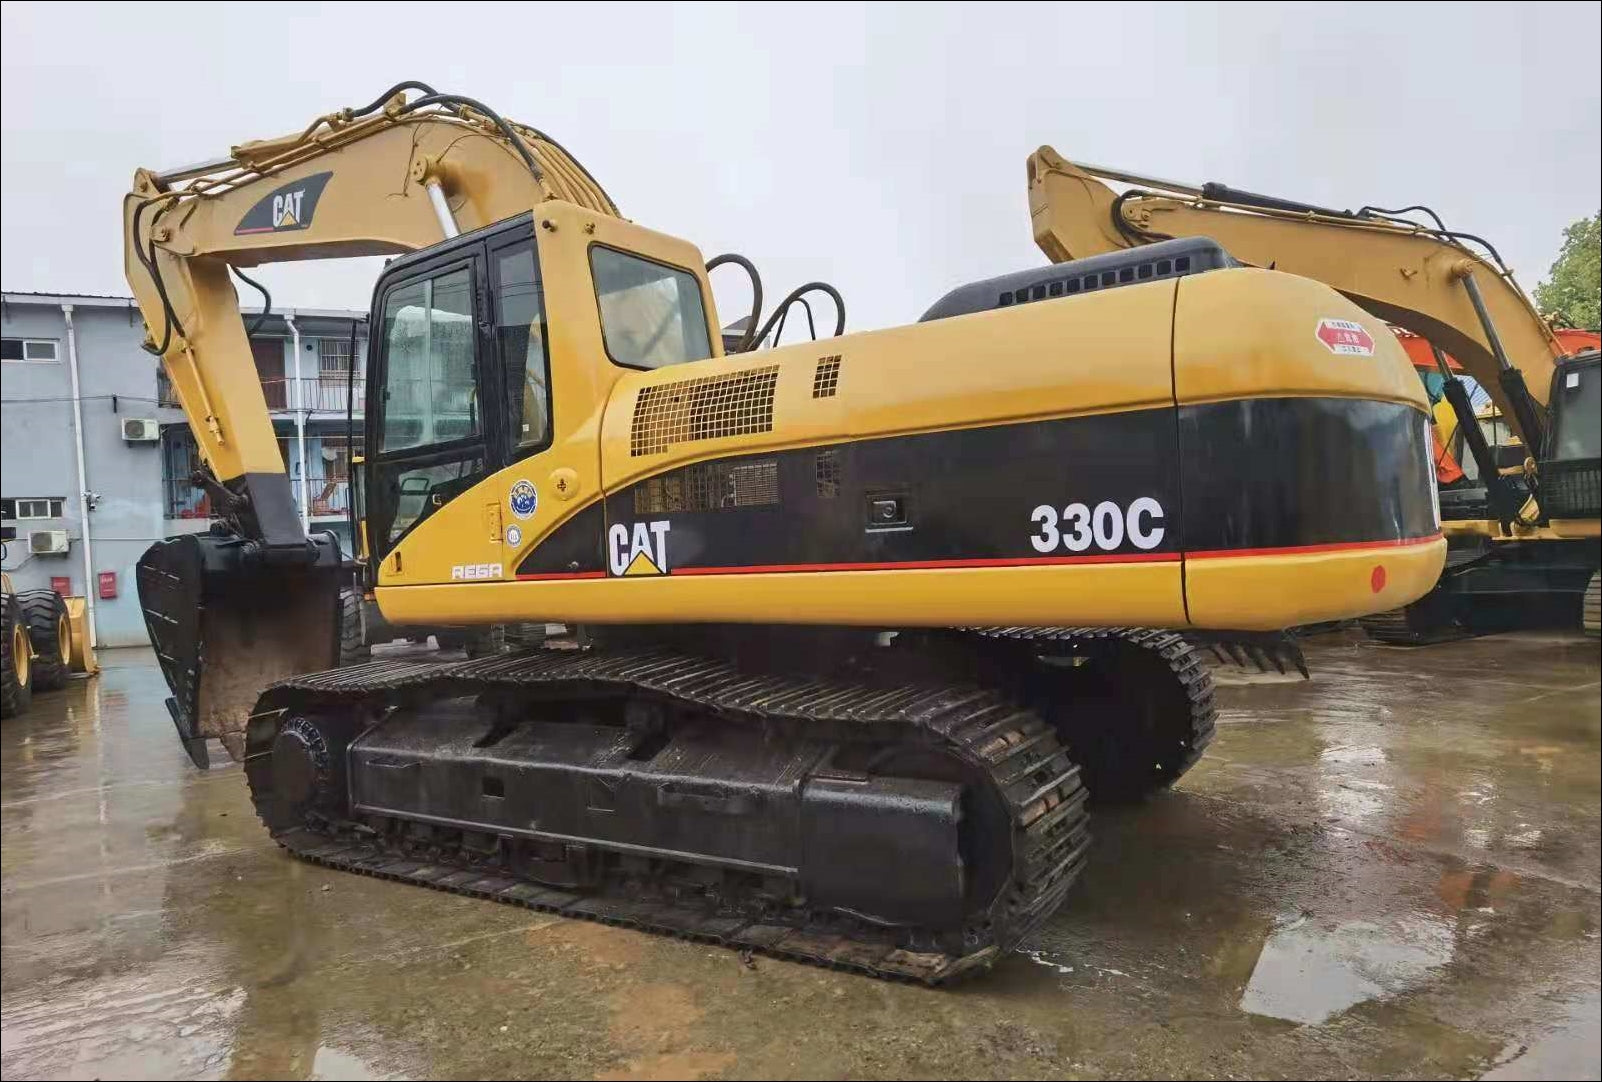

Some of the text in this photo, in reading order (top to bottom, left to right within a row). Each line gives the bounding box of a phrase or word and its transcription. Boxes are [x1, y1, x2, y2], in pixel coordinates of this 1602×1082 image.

[272, 188, 306, 228] CAT
[608, 520, 671, 576] CAT
[1030, 496, 1165, 553] 330C
